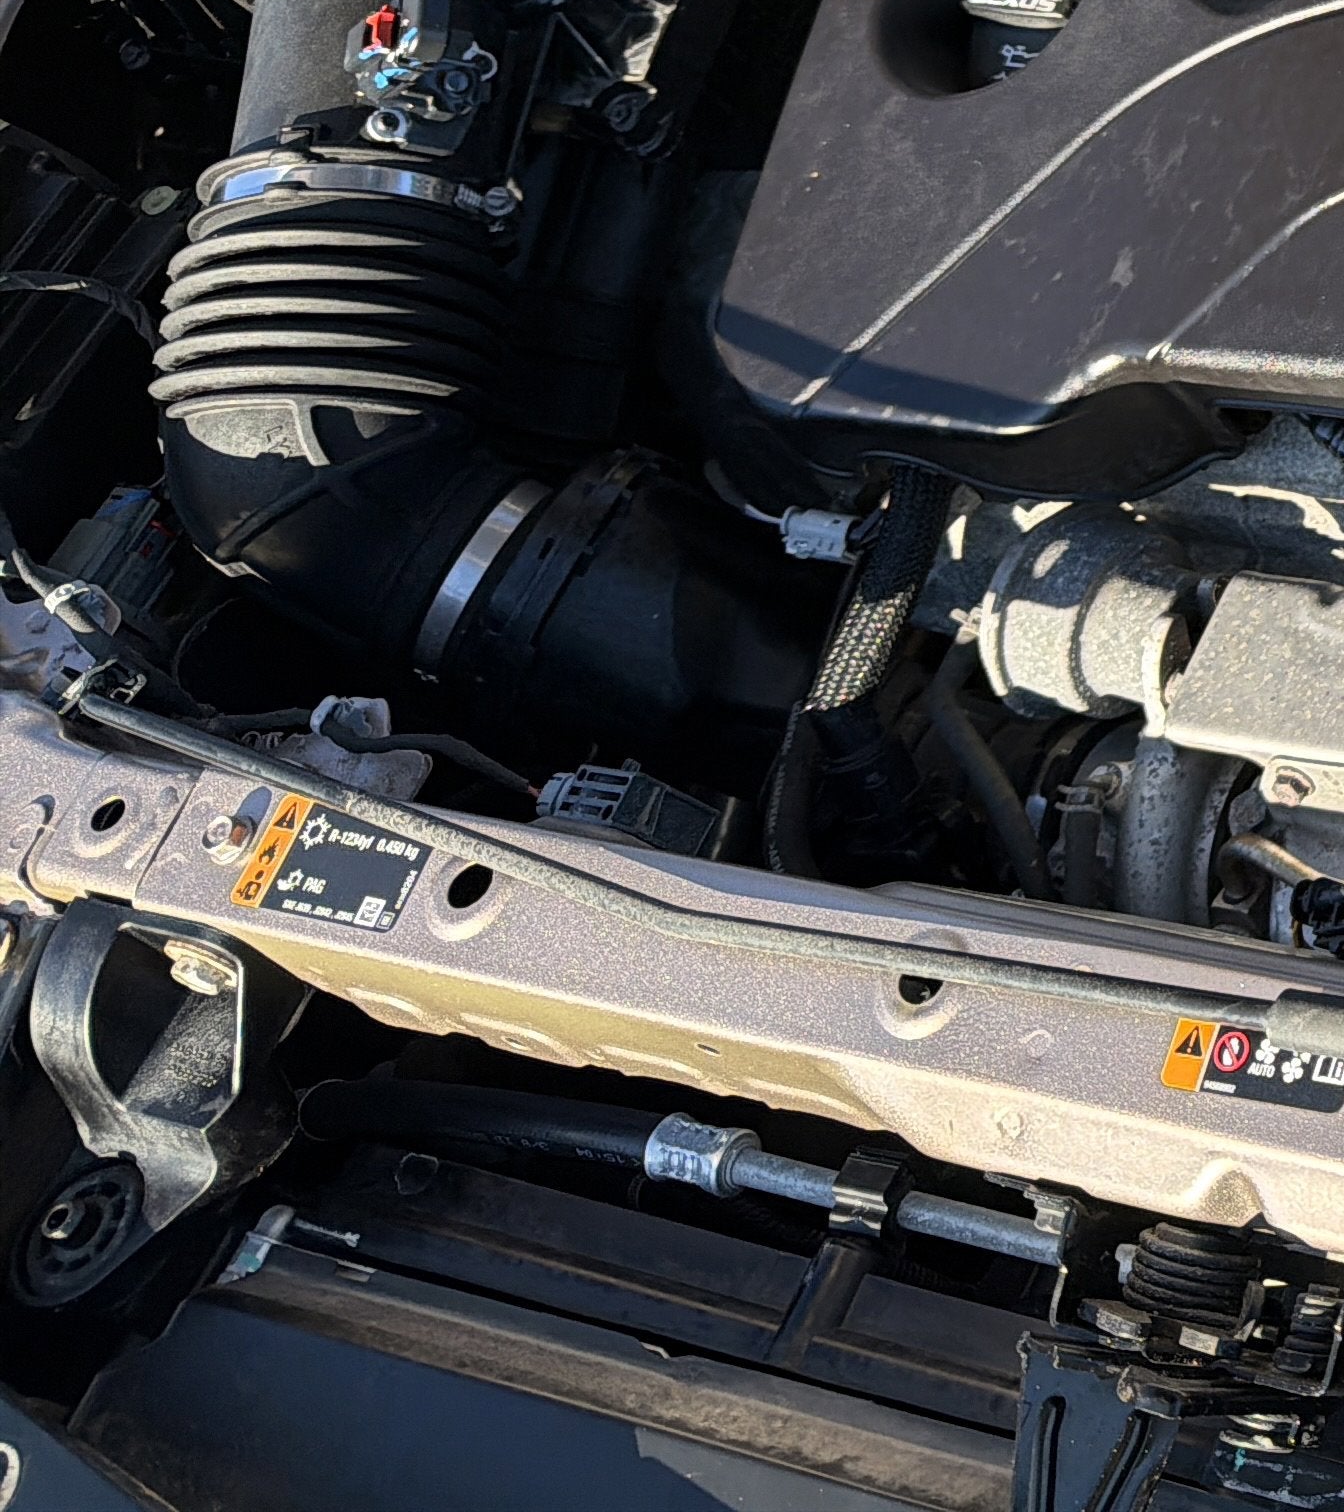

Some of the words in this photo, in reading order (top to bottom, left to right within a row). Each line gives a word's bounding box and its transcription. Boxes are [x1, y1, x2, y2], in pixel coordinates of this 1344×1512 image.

[328, 828, 375, 851] R-1234yf
[376, 838, 405, 856] 0.450
[403, 844, 420, 862] kg
[302, 876, 327, 895] PAG
[1246, 1062, 1276, 1078] AUTO
